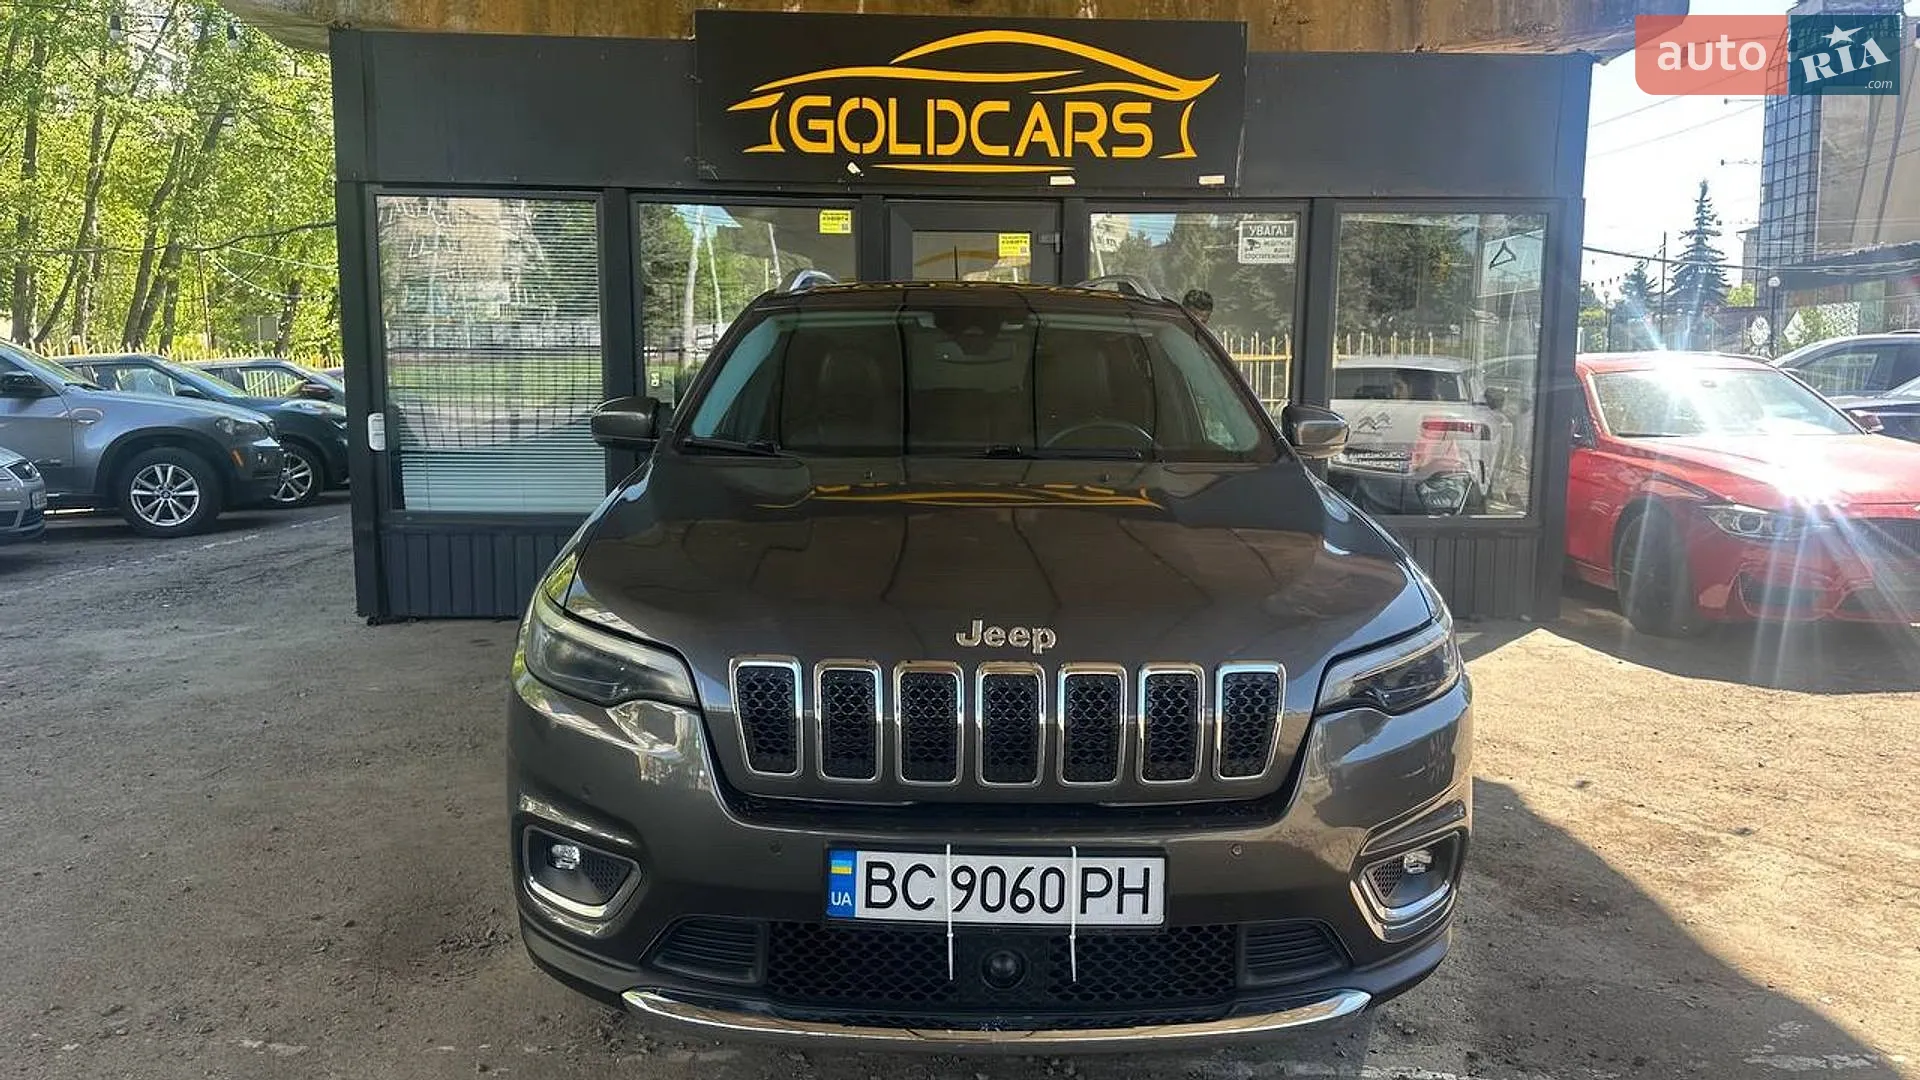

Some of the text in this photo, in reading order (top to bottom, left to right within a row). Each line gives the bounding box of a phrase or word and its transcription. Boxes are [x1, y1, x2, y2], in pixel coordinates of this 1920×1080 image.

[788, 95, 1154, 158] GOLDCARS
[1249, 224, 1288, 237] УВАГА!
[956, 619, 1056, 654] Jeep
[831, 891, 852, 906] UA
[865, 860, 1151, 915] BC 9060 PH
